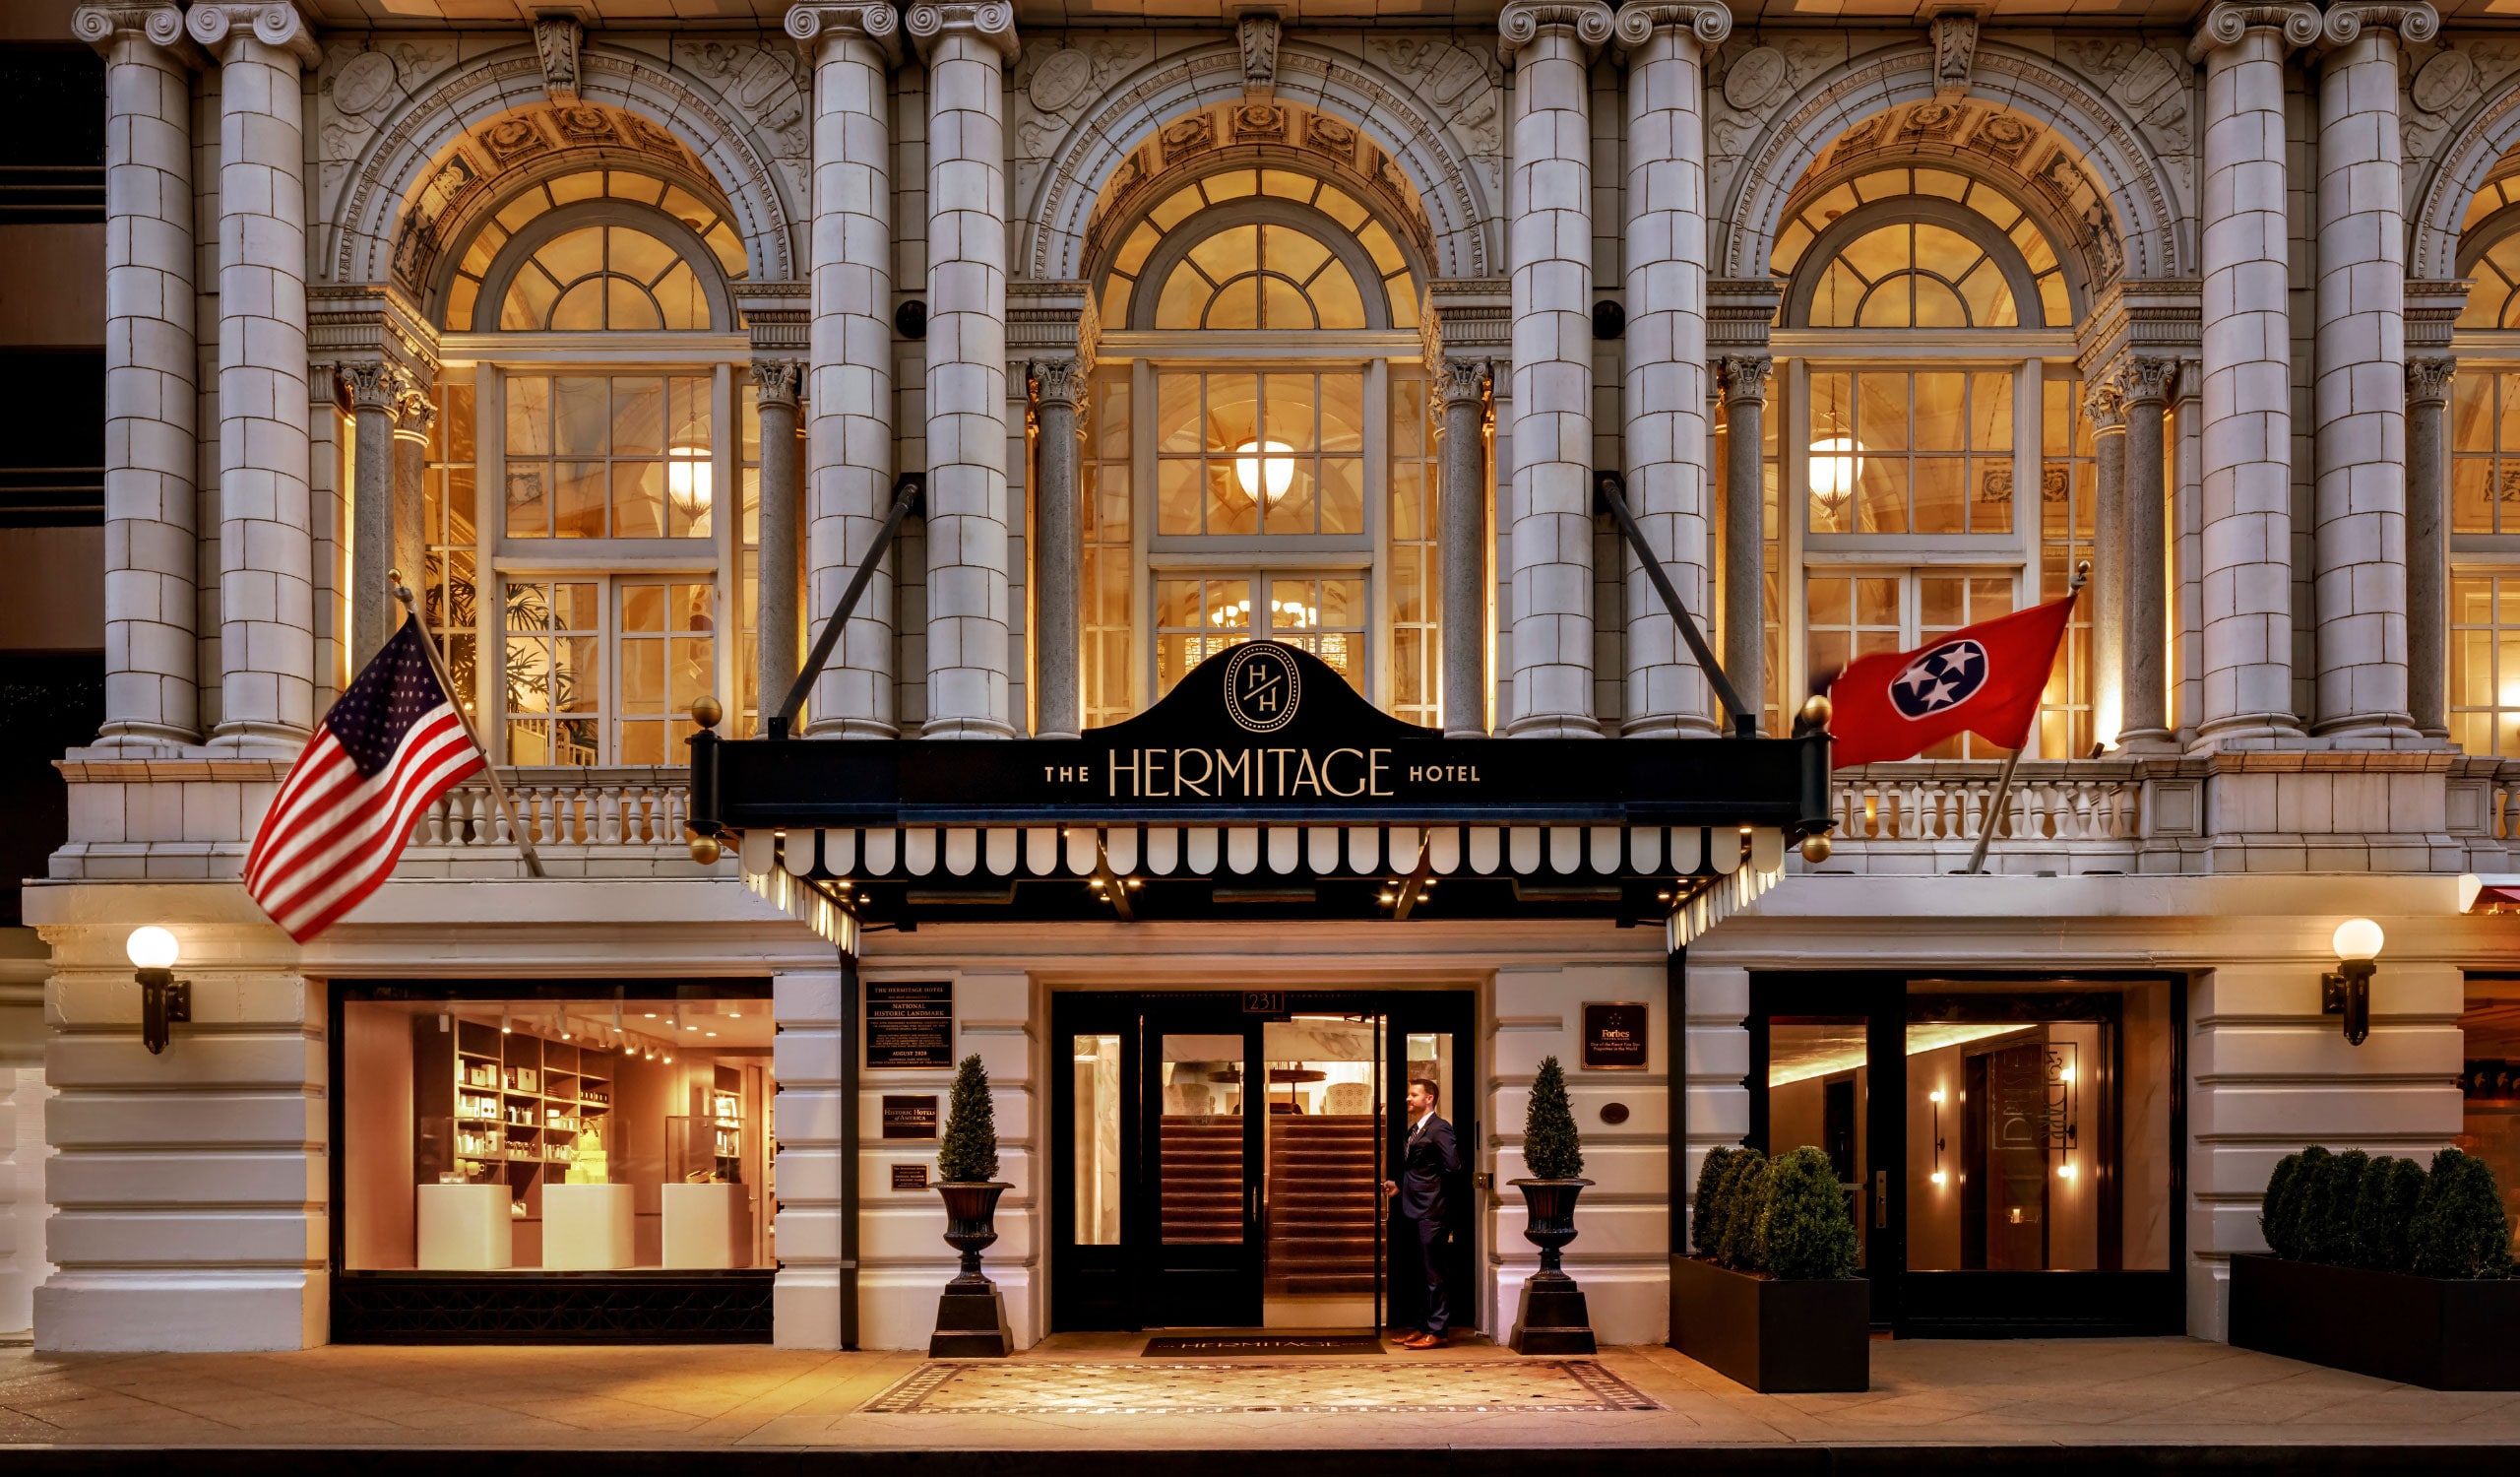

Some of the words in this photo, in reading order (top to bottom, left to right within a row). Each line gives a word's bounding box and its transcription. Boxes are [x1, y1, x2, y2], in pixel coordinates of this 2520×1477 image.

[1044, 766, 1090, 783] THE
[1108, 747, 1395, 798] HERMITAGE
[1410, 765, 1481, 782] HOTEL
[1249, 993, 1277, 1010] 231
[1602, 1029, 1630, 1038] Forbes
